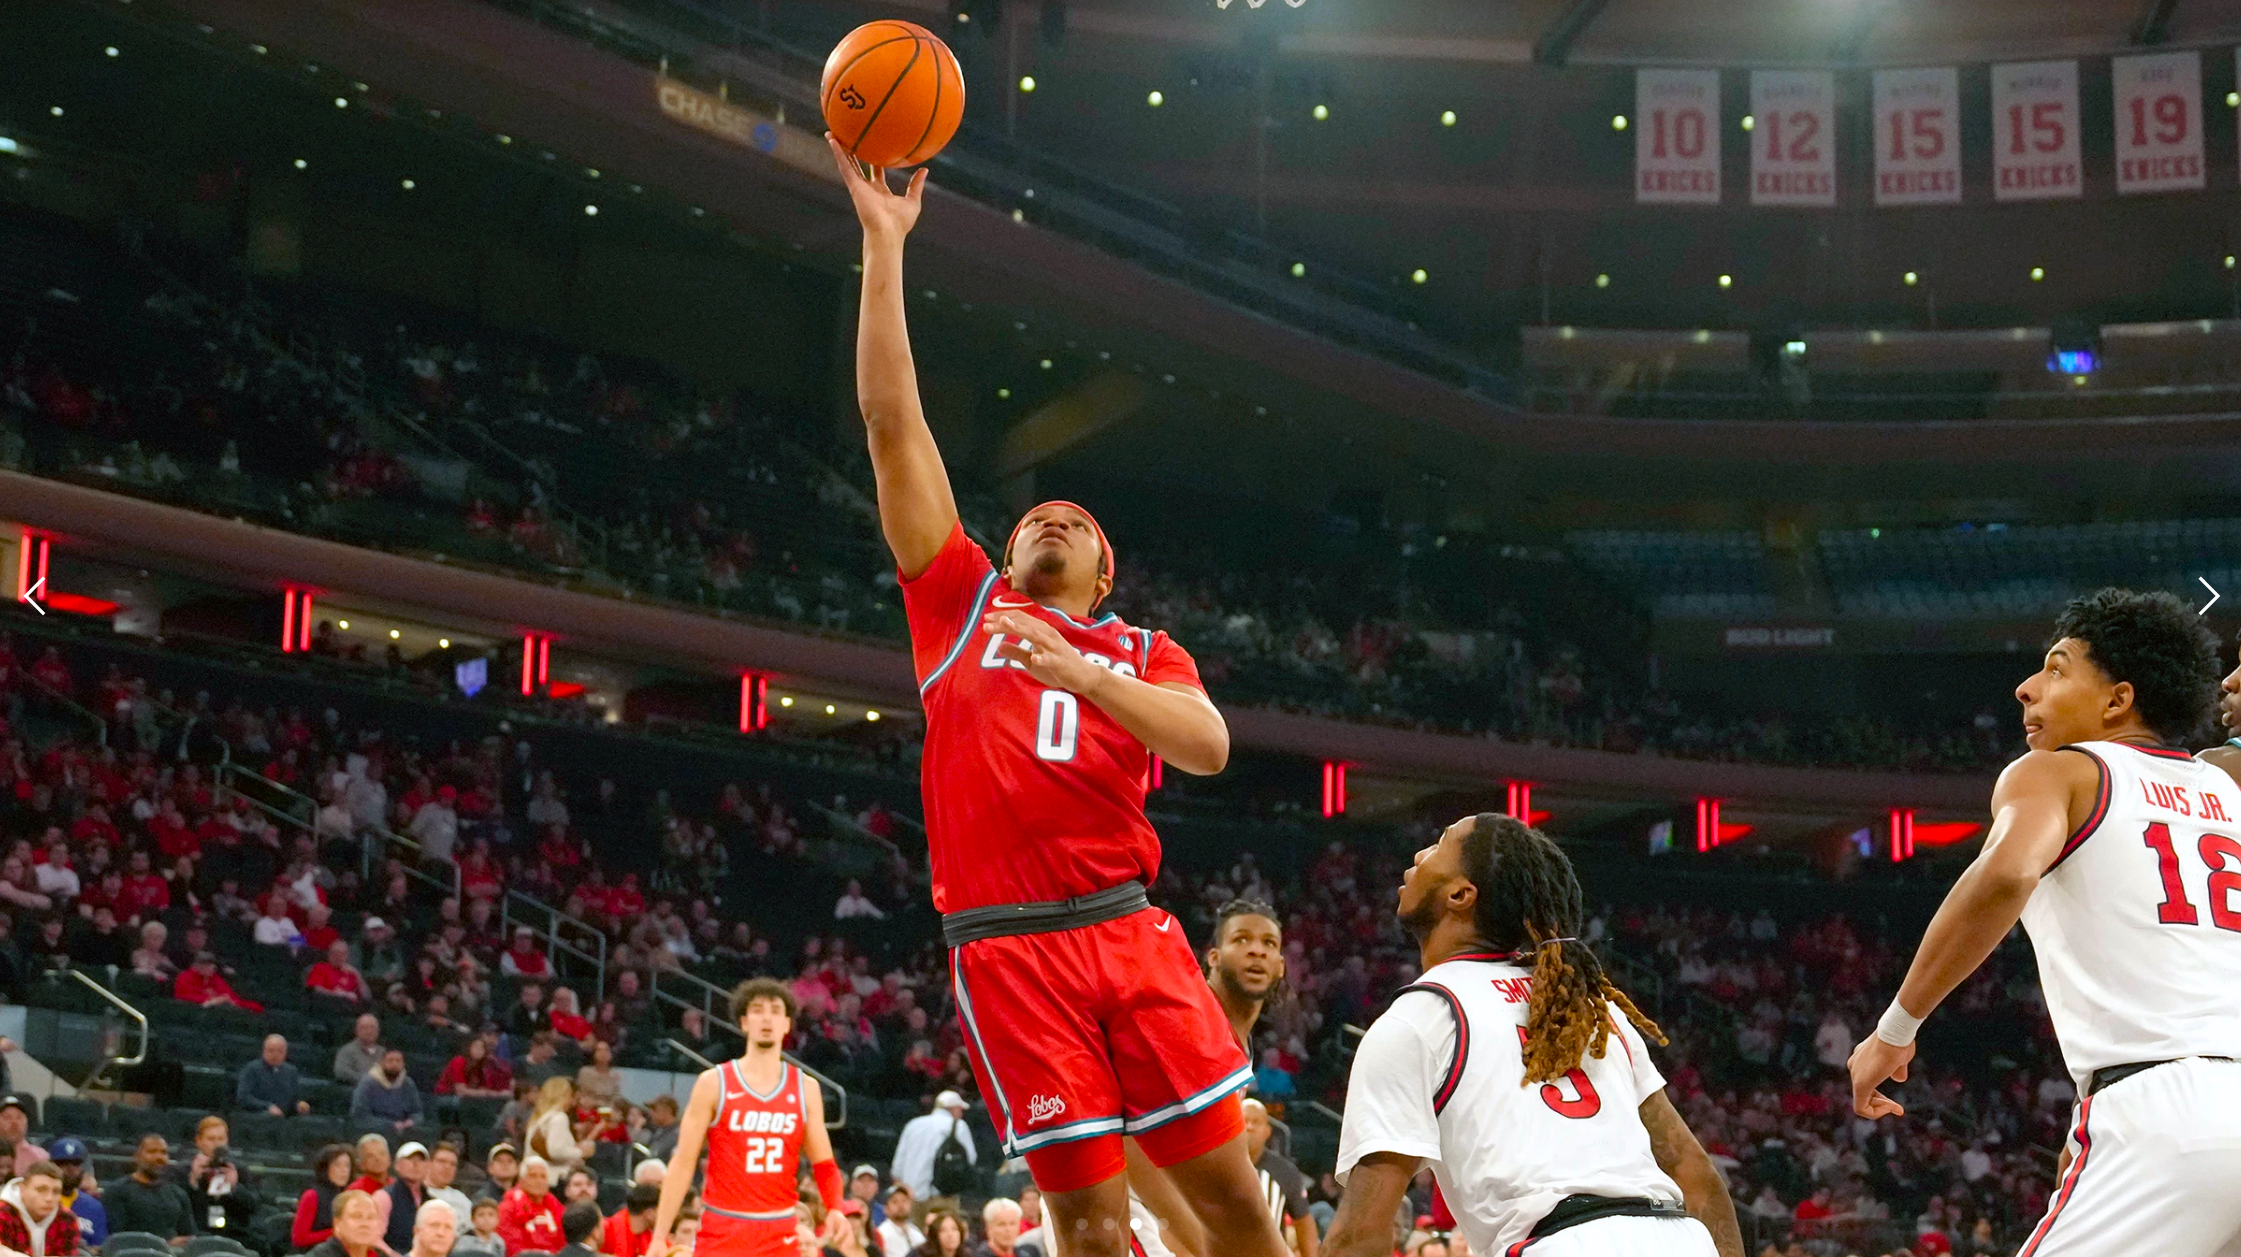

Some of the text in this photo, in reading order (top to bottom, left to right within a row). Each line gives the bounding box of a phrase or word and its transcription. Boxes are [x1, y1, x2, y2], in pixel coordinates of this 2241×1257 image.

[659, 86, 750, 139] CHASE
[2008, 103, 2064, 154] 15
[2130, 95, 2187, 146] 19
[1651, 109, 1706, 159] 10
[1766, 111, 1819, 161] 12
[1889, 109, 1945, 160] 15
[1641, 170, 1715, 193] KNICKS
[1757, 171, 1831, 195] KNICKS
[1880, 170, 1955, 195] KNICKS
[2000, 164, 2076, 189] KNICKS
[2121, 155, 2199, 181] KNICKS
[1035, 689, 1078, 762] 0
[2138, 777, 2233, 822] LUIS JR.
[729, 1110, 797, 1134] LOBOS
[1027, 1094, 1066, 1125] Lobos
[745, 1137, 784, 1173] 22
